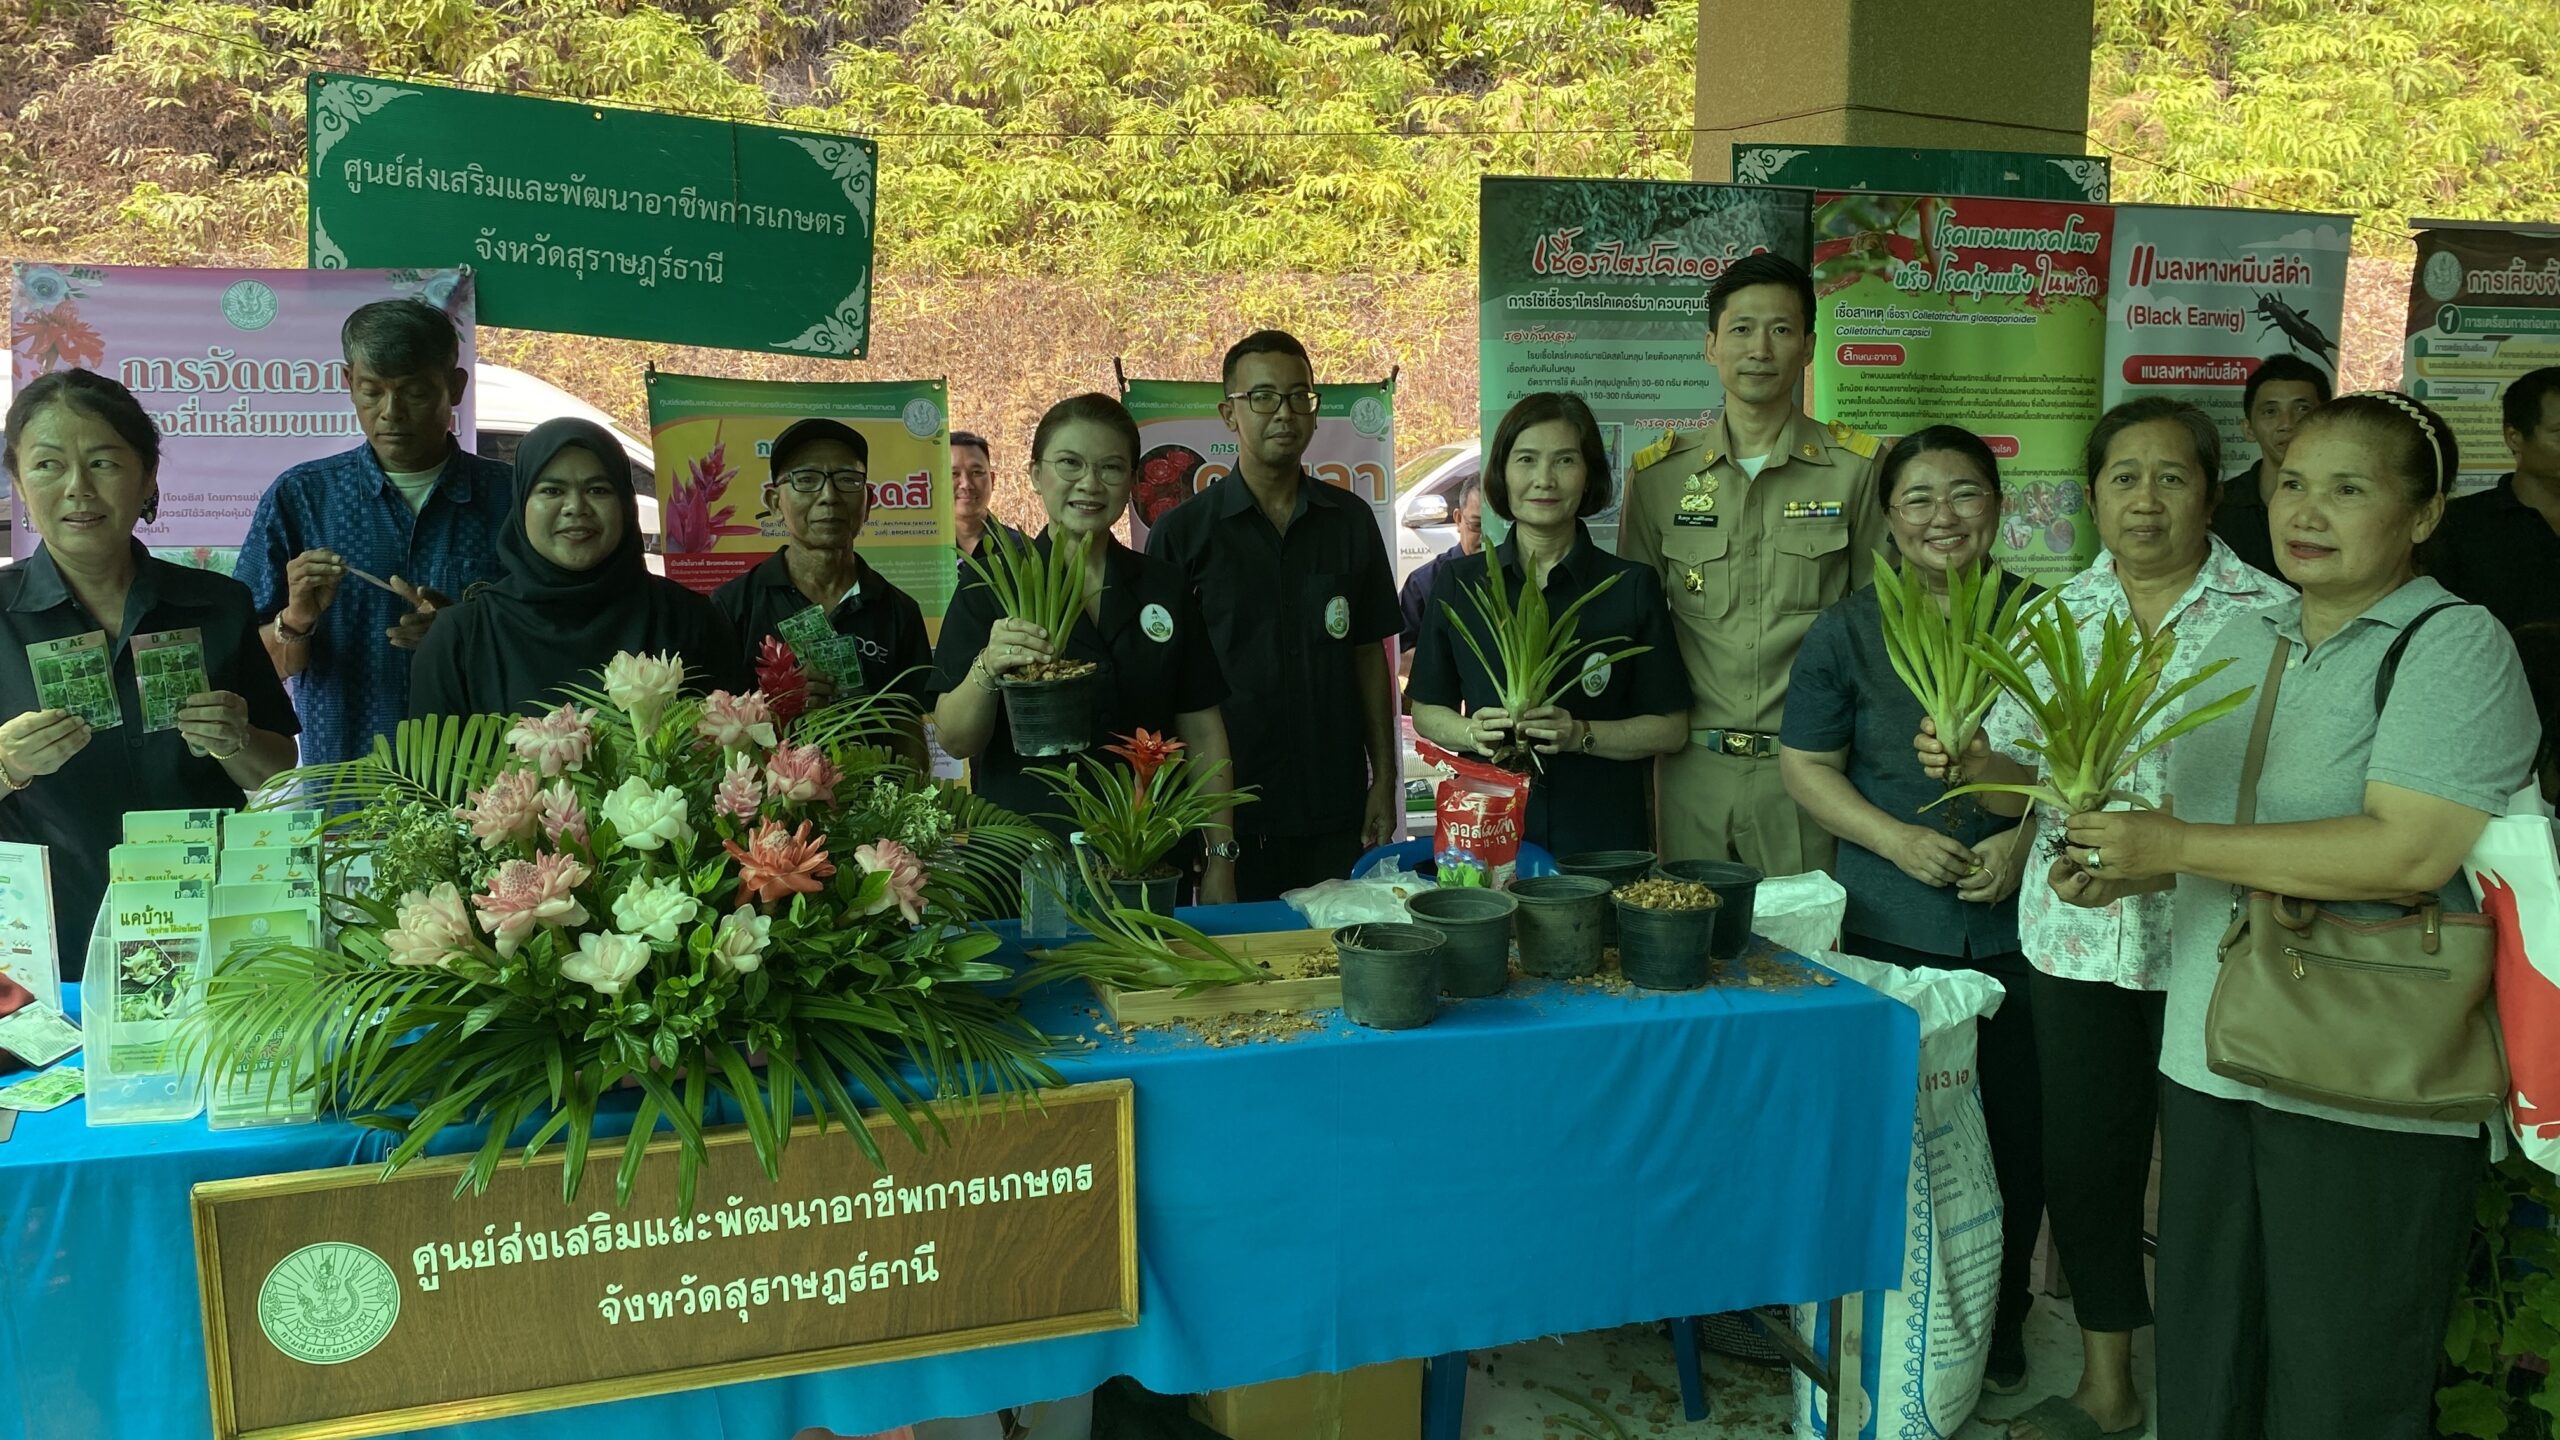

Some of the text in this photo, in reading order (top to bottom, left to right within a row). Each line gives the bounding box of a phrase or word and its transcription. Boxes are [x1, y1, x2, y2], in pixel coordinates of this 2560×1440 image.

[344, 152, 847, 236] ศูนย์ส่งเสริมและพัฒนาอาชีพการเกษตร
[1933, 207, 2100, 254] โรคแอนแทรคโนส
[474, 227, 725, 288] จังหวัดสุราษฎร์ธานี
[2128, 245, 2312, 286] แมลงหางหนีบสีดำ
[1894, 254, 2098, 301] หรือ โรคกุ้งแห้ง ในพริก
[1508, 288, 1654, 311] การใช้เชื้อราไตรโคเดอร์มา
[1835, 302, 1885, 322] เชื้อสาเหตุ
[1886, 305, 1910, 320] เชื้อรา
[1912, 310, 1969, 324] Colletotrichum
[1836, 327, 1931, 339] Colletotrichum capsici
[2127, 305, 2246, 333] (Black Earwig)
[2444, 310, 2454, 330] 1
[1843, 346, 1898, 362] ลักษณะอาการ
[1642, 379, 1664, 387] 30-60
[2141, 363, 2248, 380] แมลงหางหนีบสีดำ
[120, 904, 174, 926] แคบ้าน
[411, 1162, 1095, 1293] ศูนย์ส่งเสริมและพัฒนาอาชีพการเกษตร
[597, 1240, 941, 1326] จังหวัดสุราษฎร์ธานี
[280, 1319, 384, 1355] กรมส่งเสริมการเกษตร
